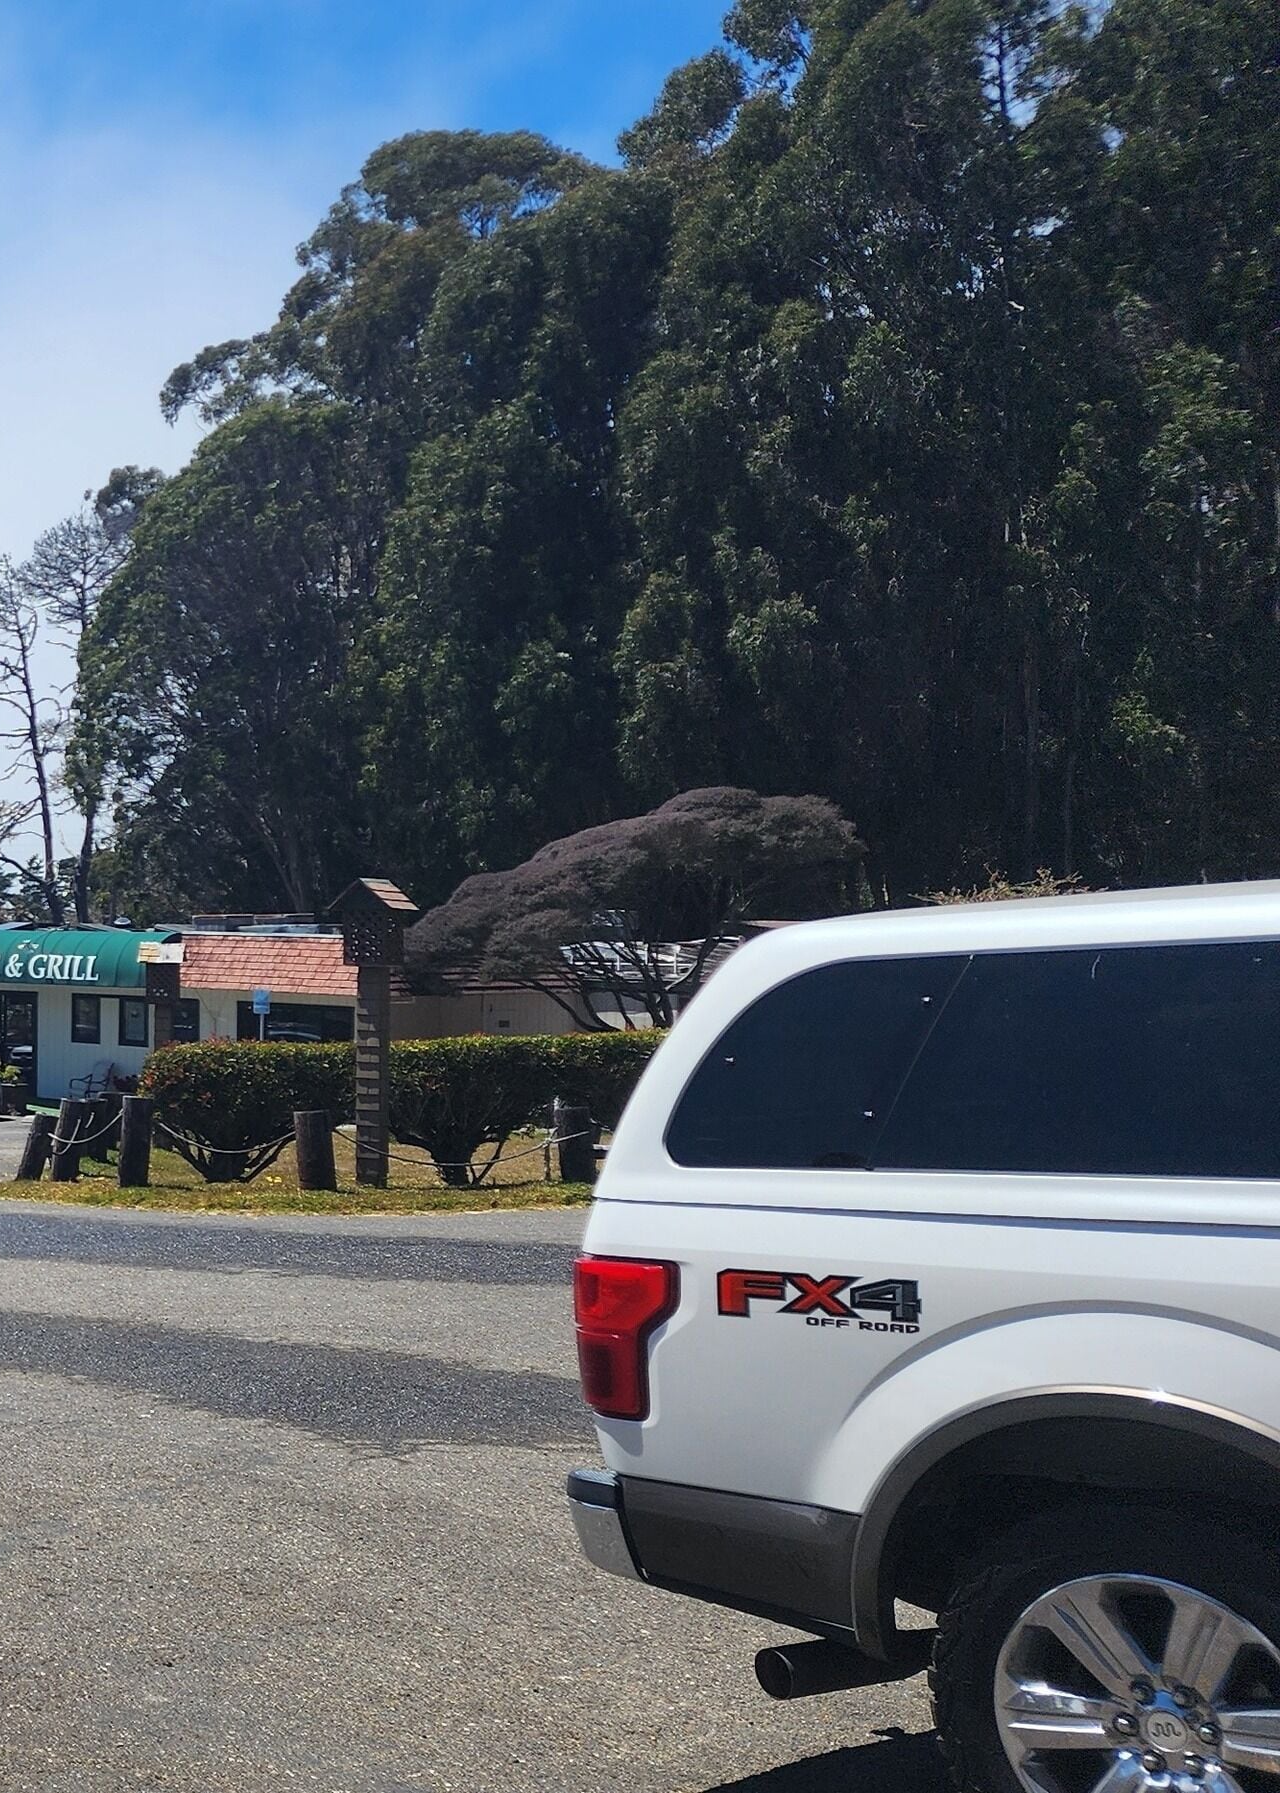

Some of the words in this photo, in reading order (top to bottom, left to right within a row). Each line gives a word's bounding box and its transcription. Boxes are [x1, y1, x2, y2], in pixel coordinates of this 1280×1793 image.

[4, 953, 24, 978] &
[27, 954, 99, 981] GRILL
[716, 1268, 922, 1324] FX4
[805, 1316, 850, 1329] OFF
[858, 1320, 920, 1335] ROAD
